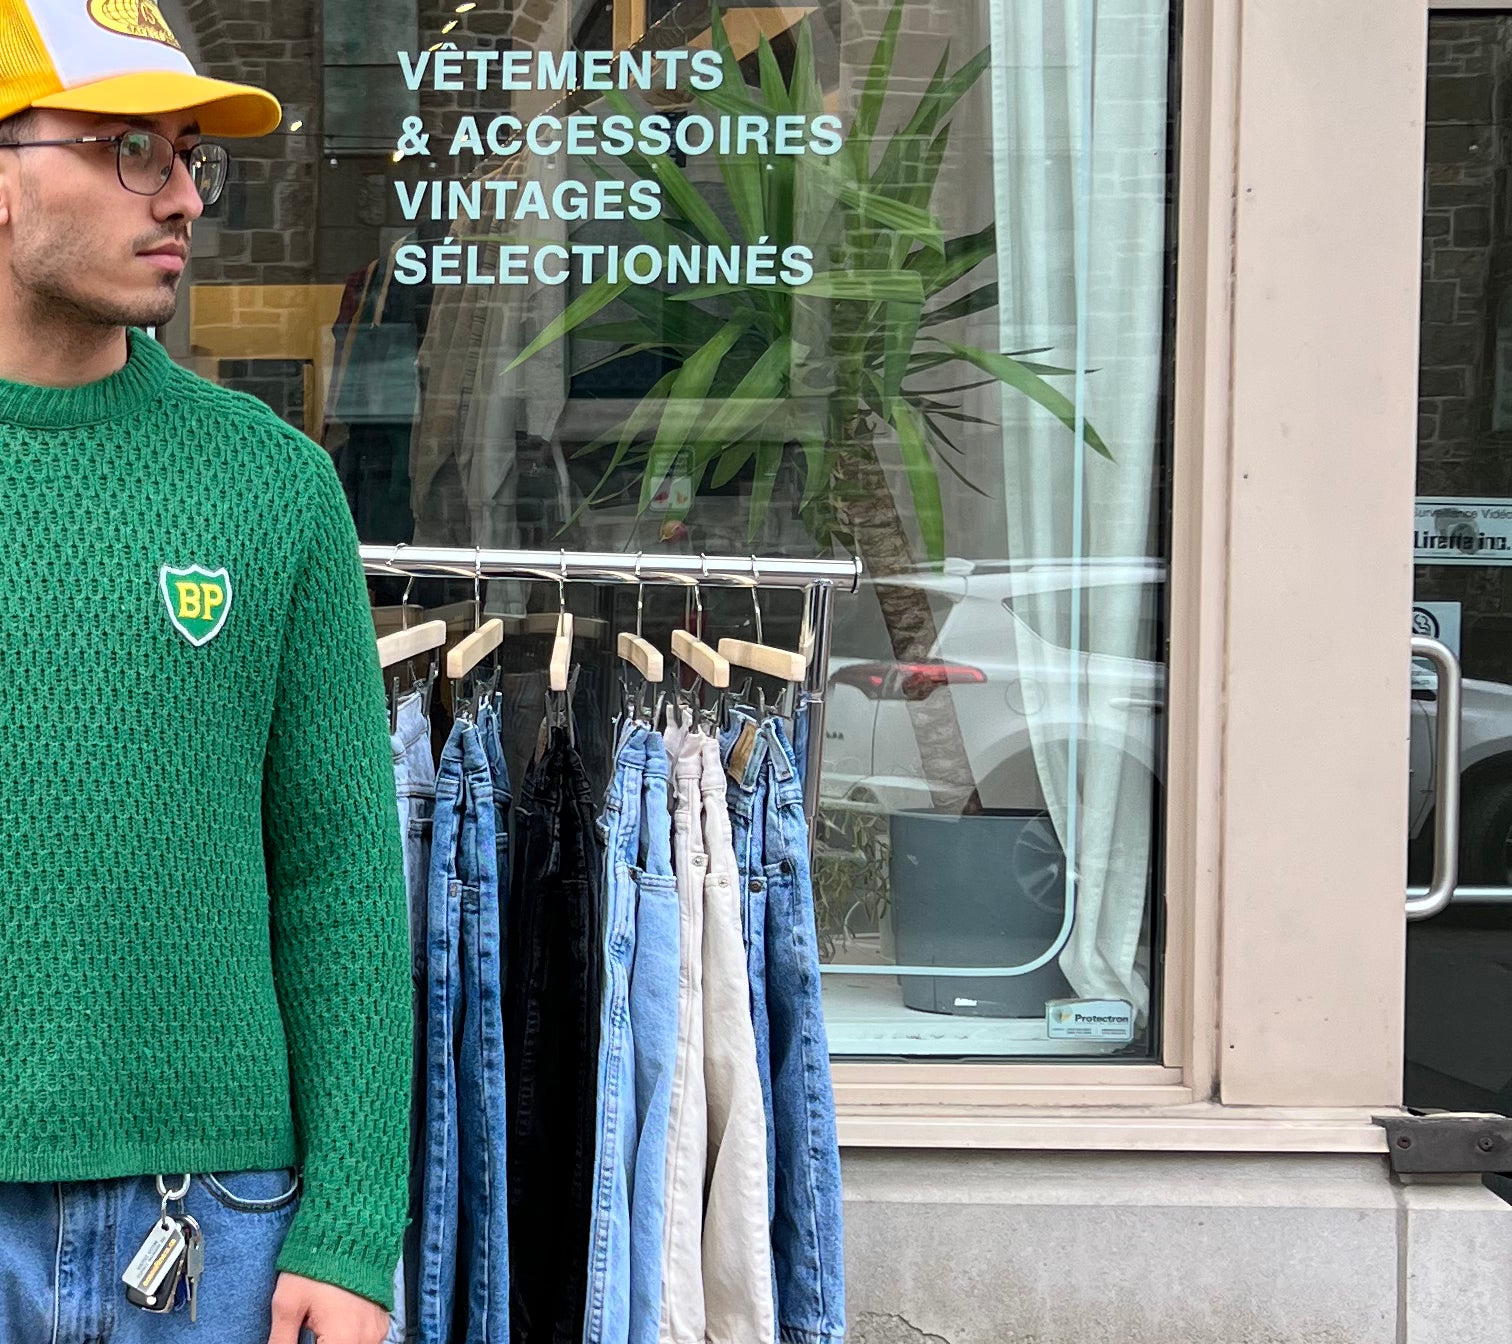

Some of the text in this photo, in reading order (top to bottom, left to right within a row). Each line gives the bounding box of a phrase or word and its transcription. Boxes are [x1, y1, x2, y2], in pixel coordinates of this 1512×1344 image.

[398, 42, 724, 91] VÊTEMENTS
[397, 115, 843, 155] & ACCESSOIRES
[394, 180, 662, 220] VINTAGES
[394, 236, 814, 286] SÉLECTIONNÉS
[175, 581, 224, 621] BP
[1074, 1013, 1129, 1024] Protectron
